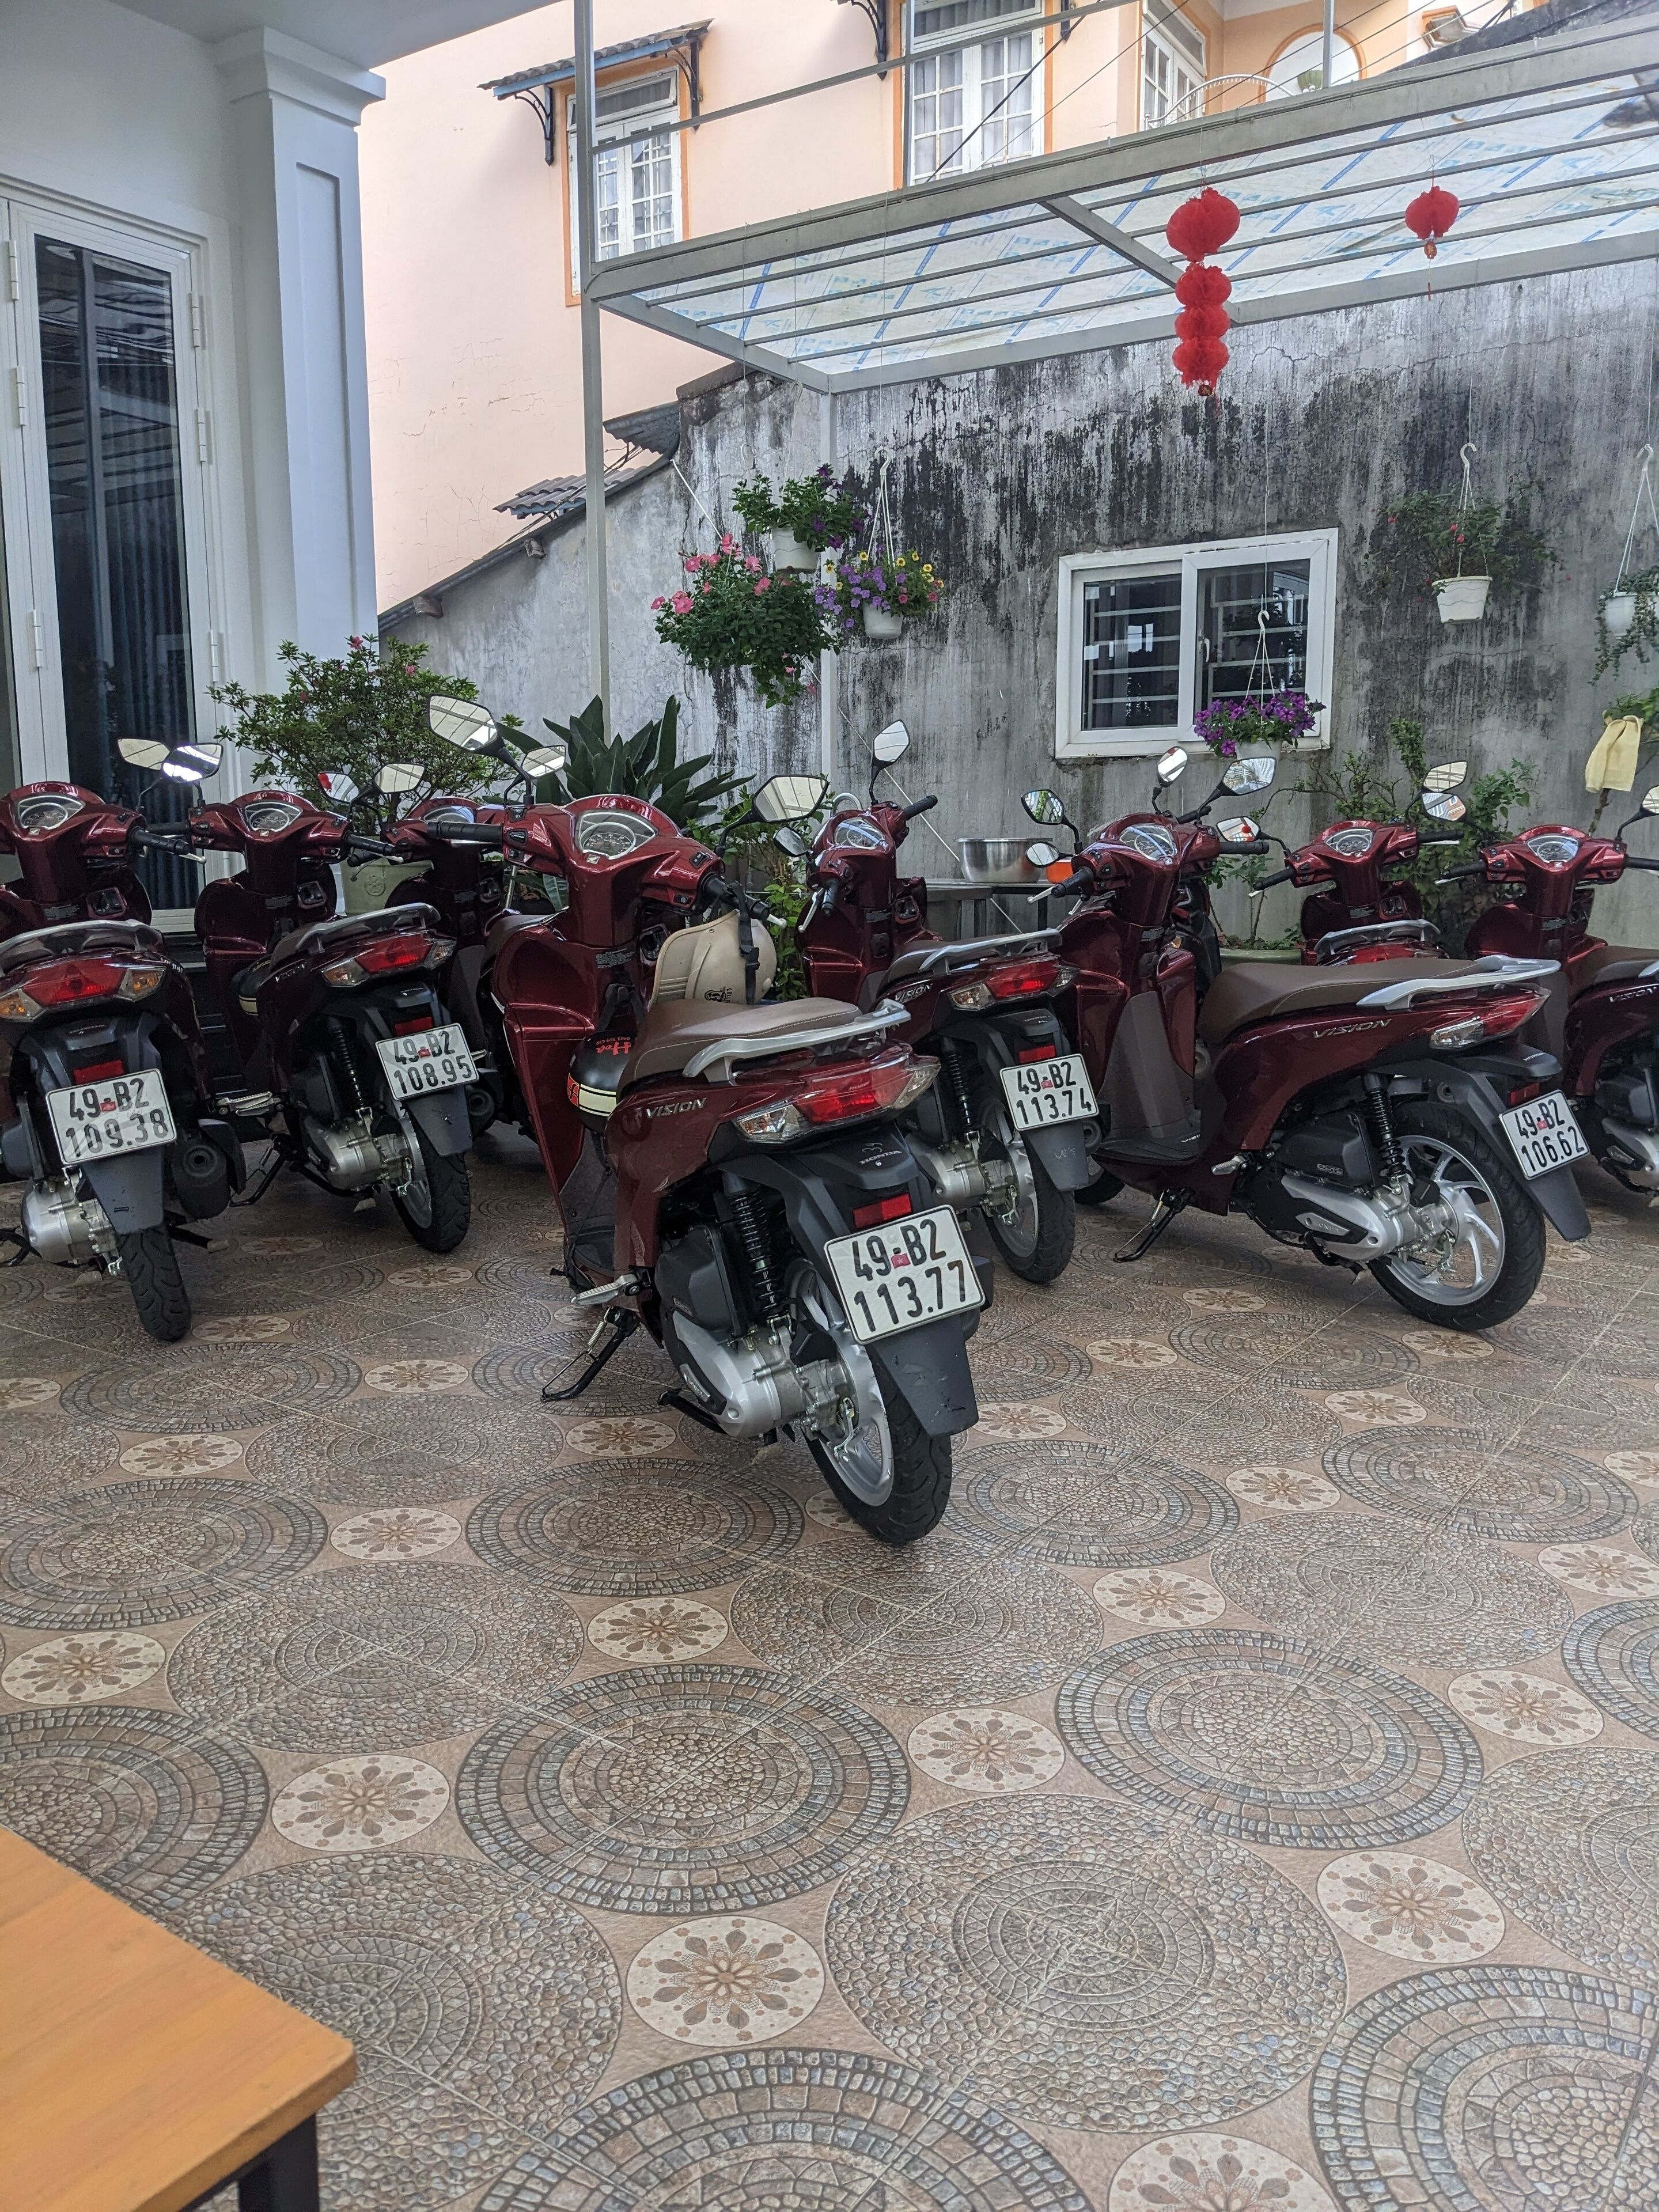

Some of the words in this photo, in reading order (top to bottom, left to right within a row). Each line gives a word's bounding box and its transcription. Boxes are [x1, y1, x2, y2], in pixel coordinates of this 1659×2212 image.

[1312, 1018, 1392, 1039] VISION
[393, 1055, 472, 1094] 108.95
[645, 1097, 707, 1119] VISION
[1016, 1088, 1092, 1125] 113.74
[66, 1109, 169, 1158] 109.38
[1521, 1126, 1585, 1172] 106.62
[854, 1259, 965, 1332] 113.77
